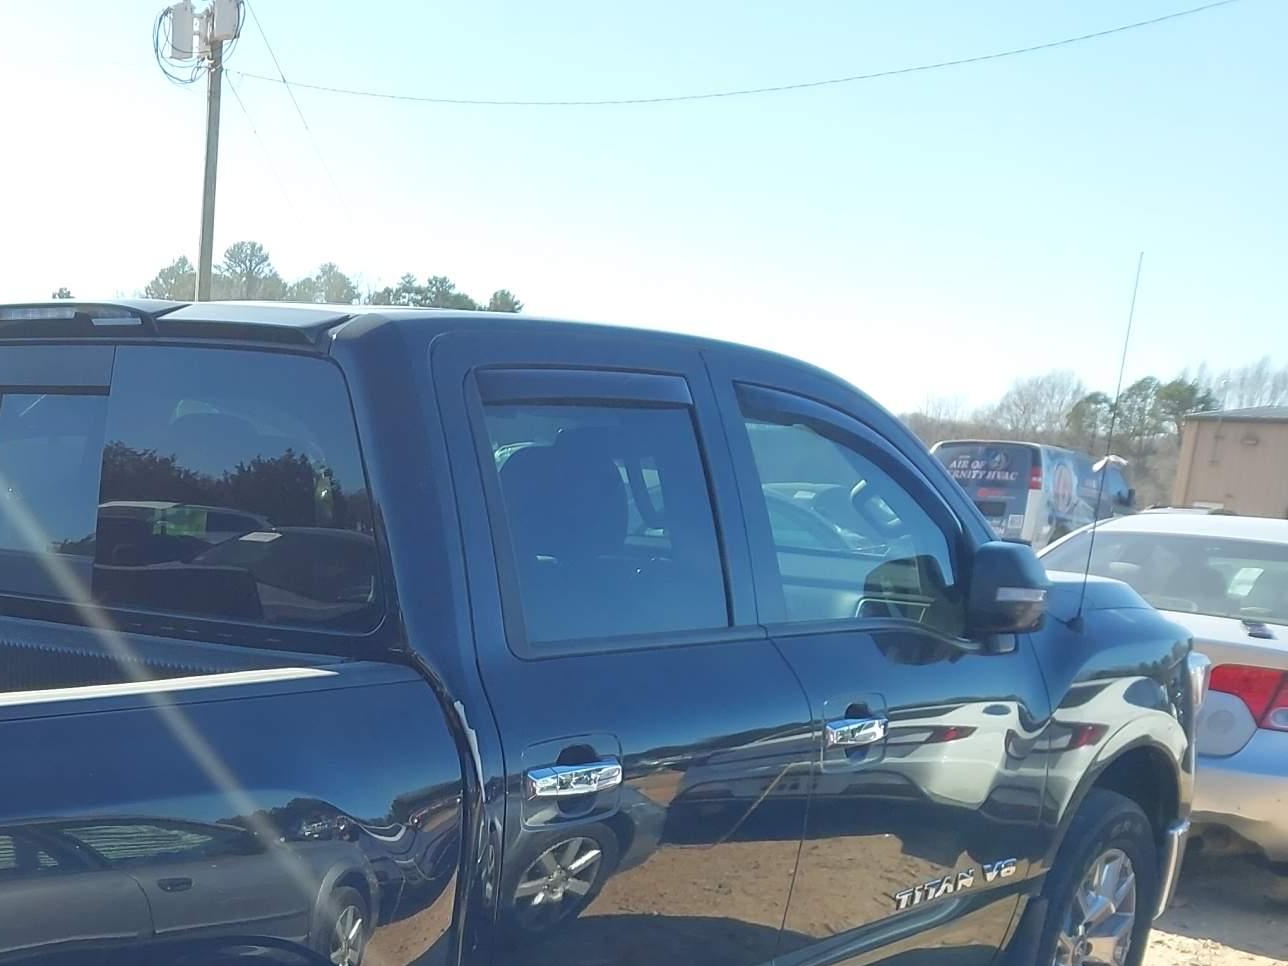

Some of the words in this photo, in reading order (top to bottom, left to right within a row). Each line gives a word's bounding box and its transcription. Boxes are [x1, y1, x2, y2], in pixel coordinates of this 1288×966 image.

[949, 460, 969, 469] AIR
[986, 471, 1016, 480] HVAC
[896, 868, 975, 909] TITAN
